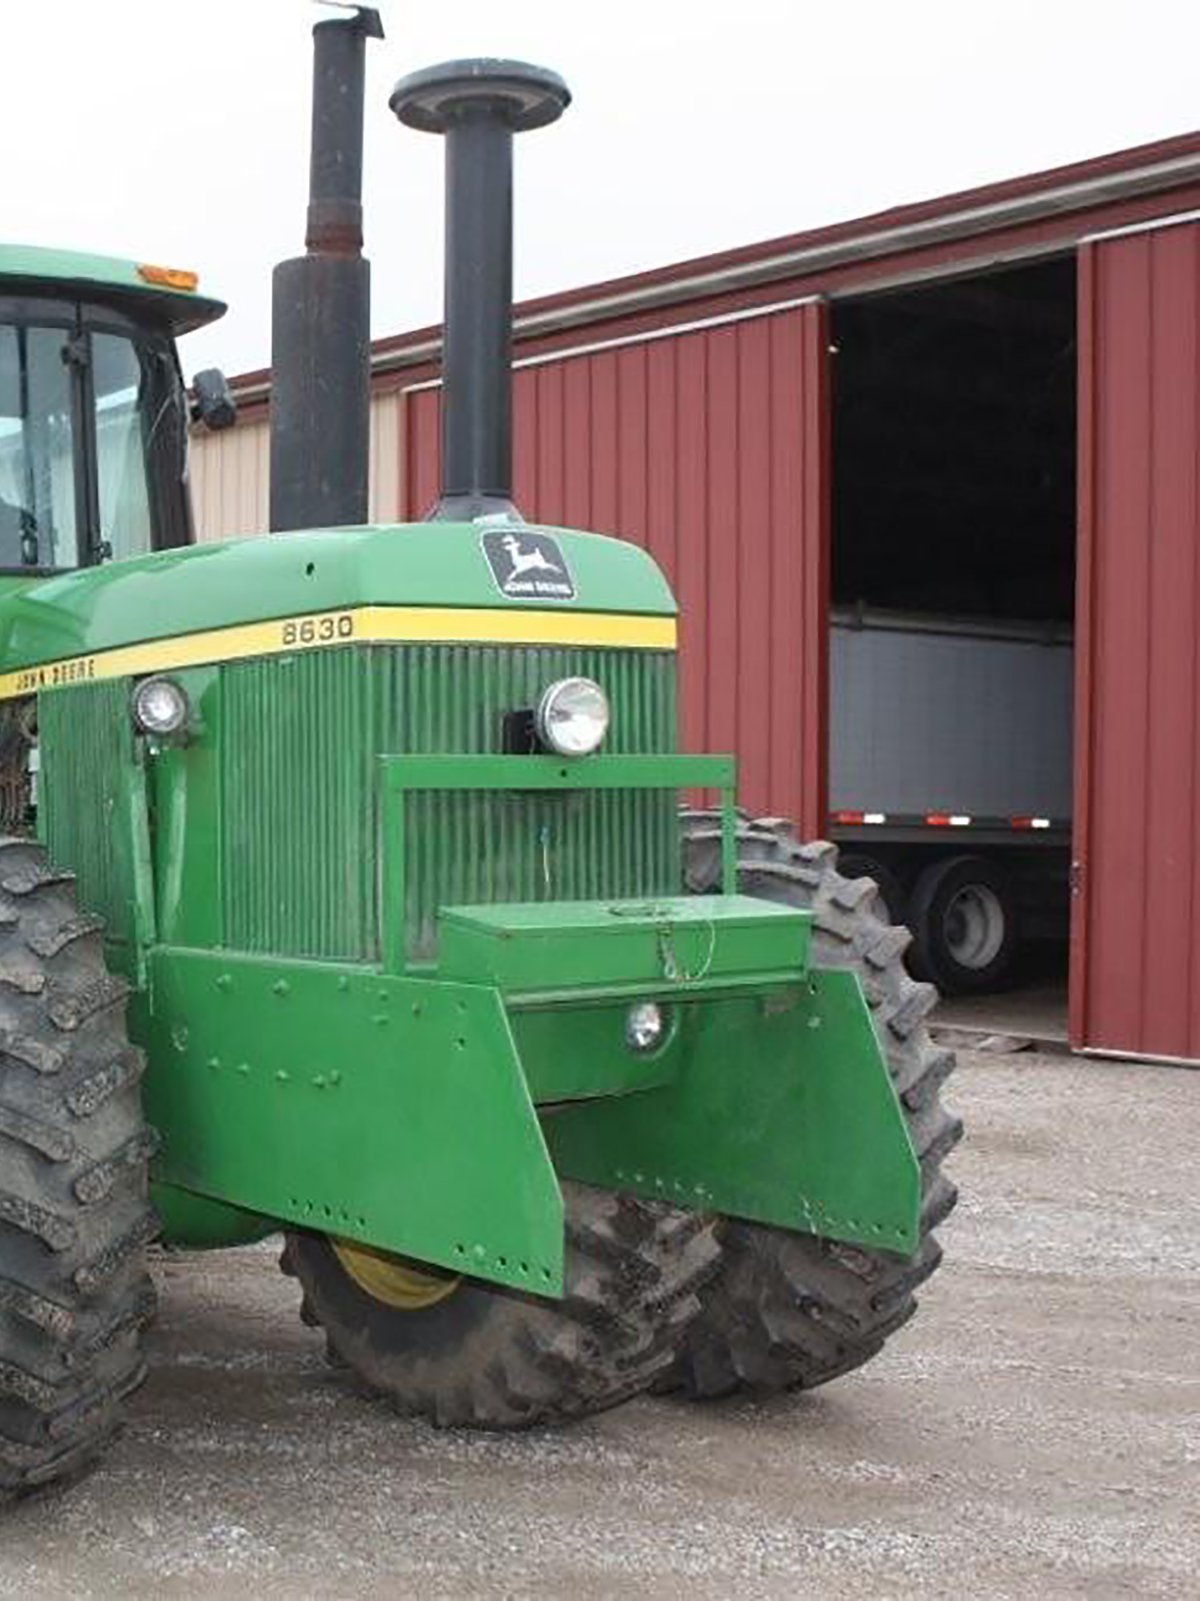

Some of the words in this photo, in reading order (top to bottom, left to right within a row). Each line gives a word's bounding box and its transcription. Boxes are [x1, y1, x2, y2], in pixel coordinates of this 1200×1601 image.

[282, 615, 354, 645] 8630
[16, 669, 46, 691] JOHN
[52, 659, 95, 685] DEERE
